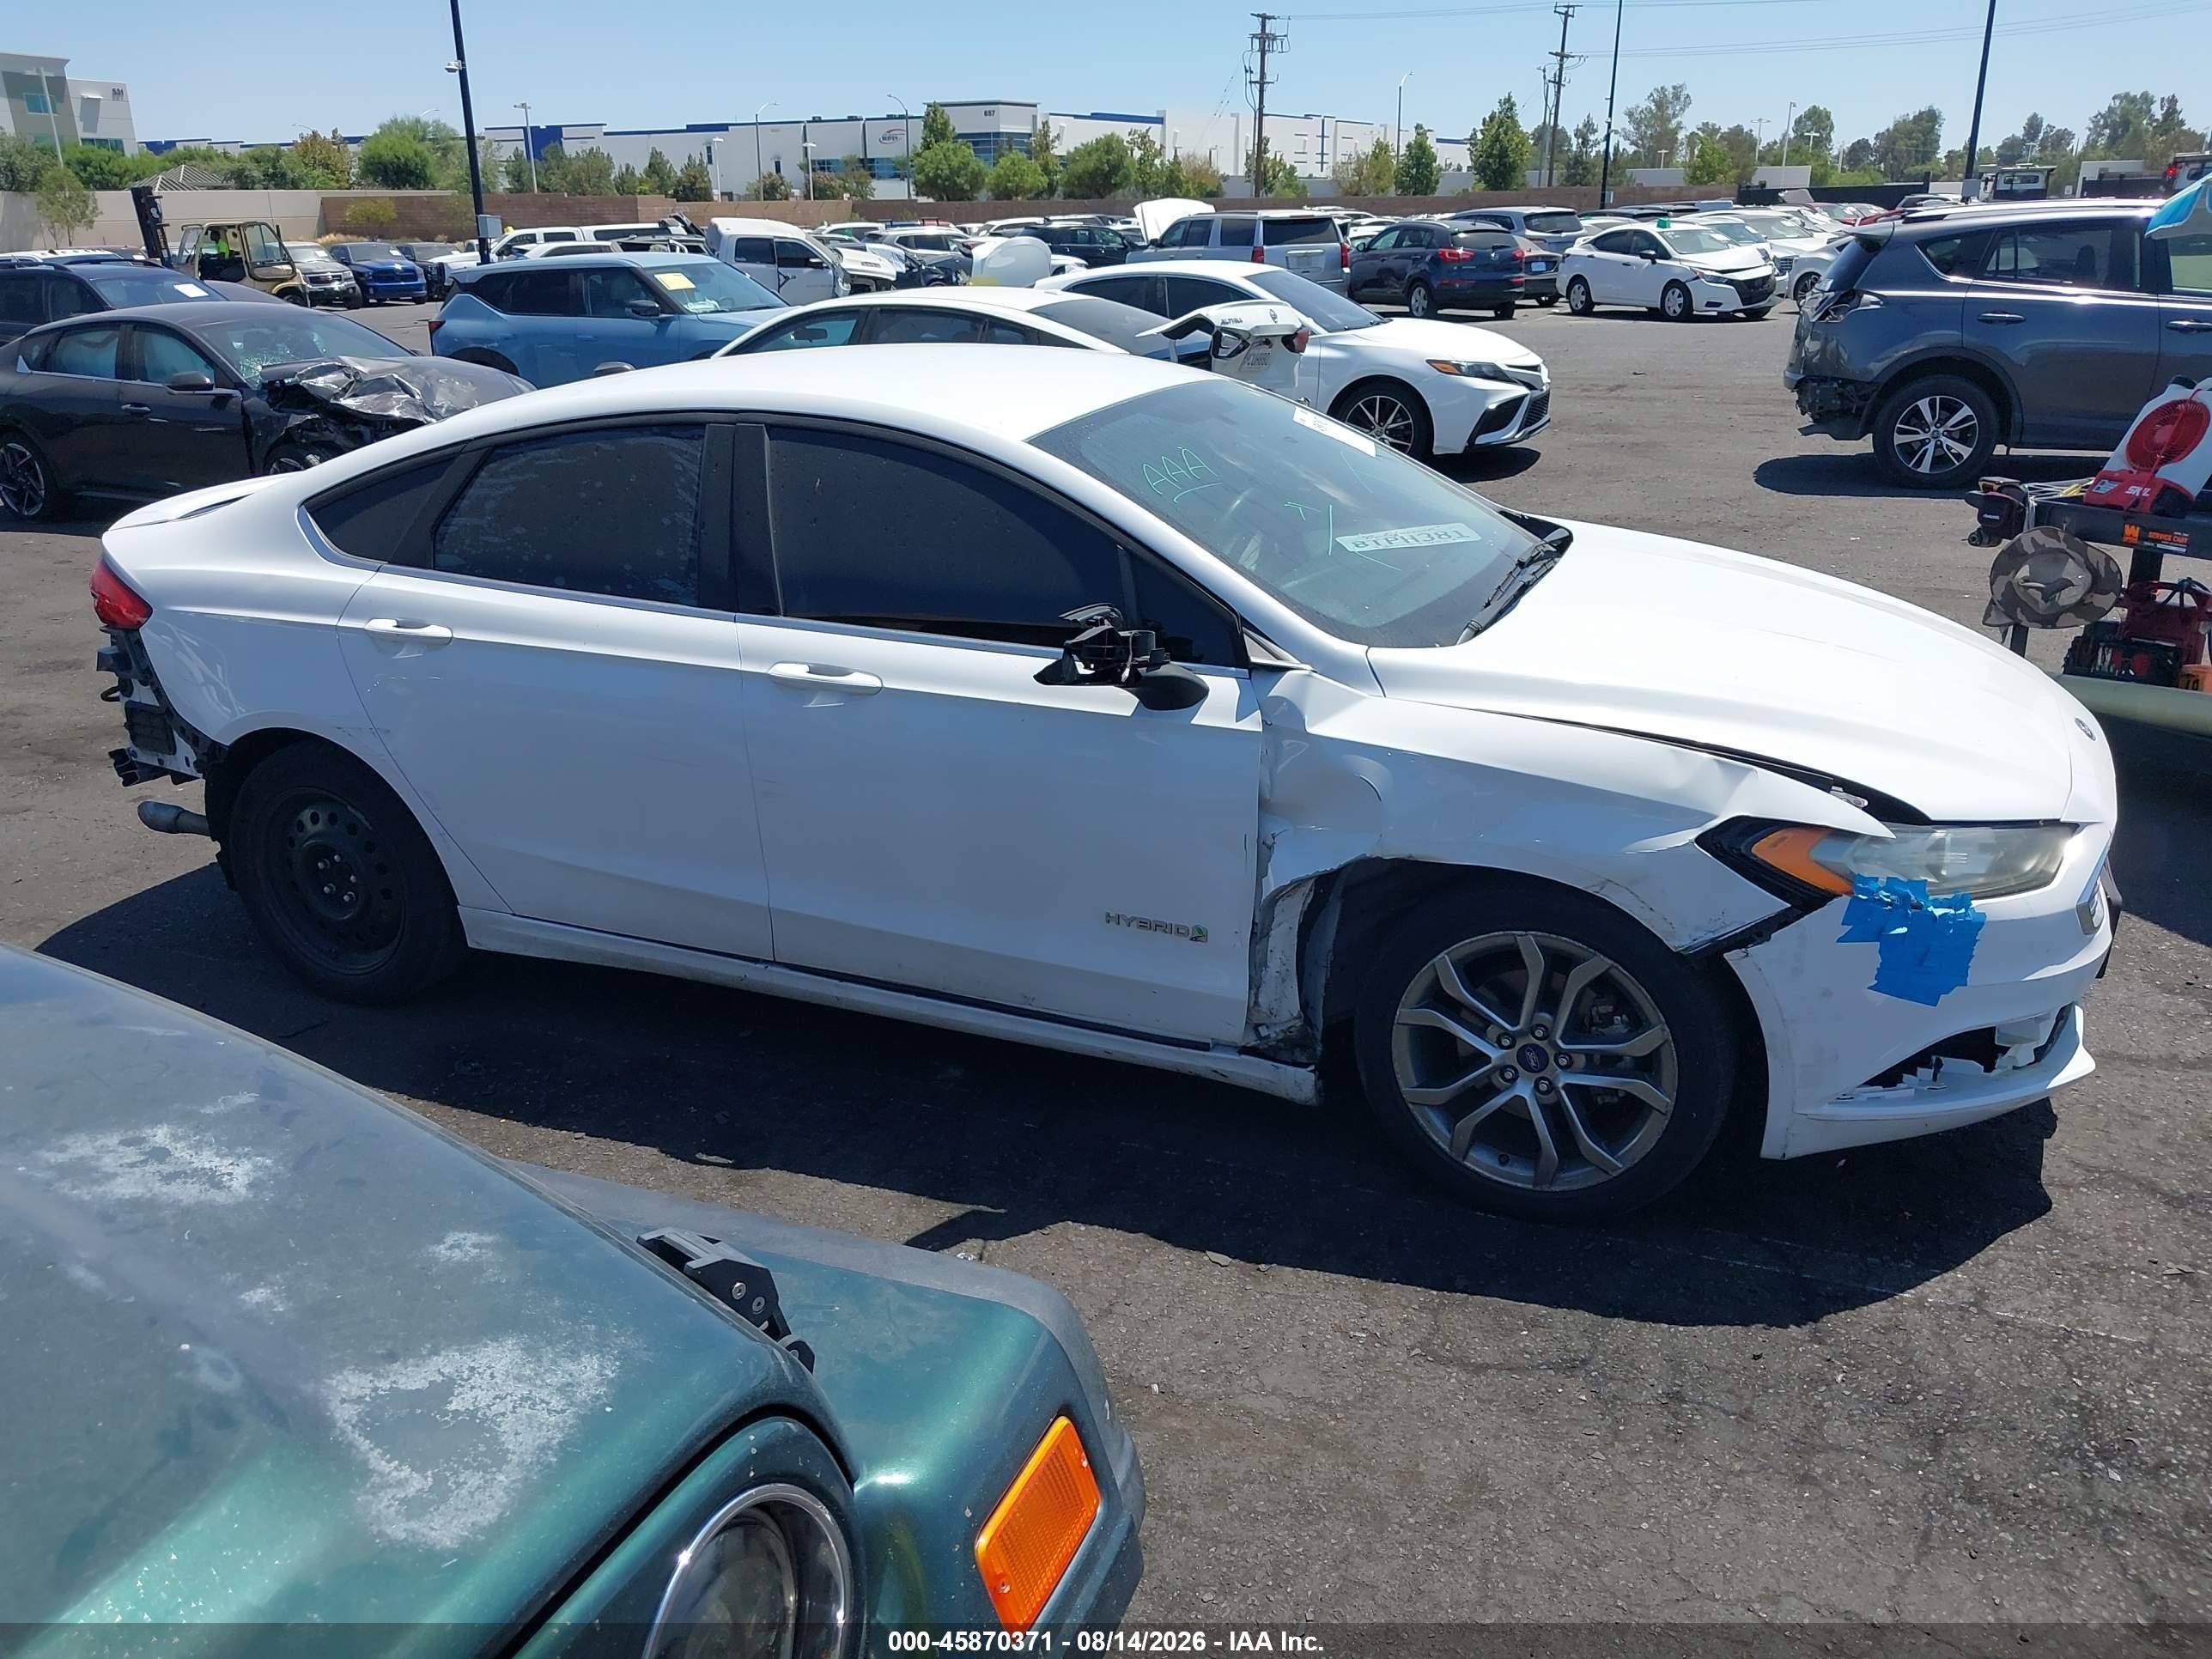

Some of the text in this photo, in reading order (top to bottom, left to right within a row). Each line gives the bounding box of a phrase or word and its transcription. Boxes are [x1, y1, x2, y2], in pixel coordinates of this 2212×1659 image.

[112, 88, 124, 96] 531
[1142, 447, 1218, 495] AAA
[1105, 911, 1190, 938] HYBRID
